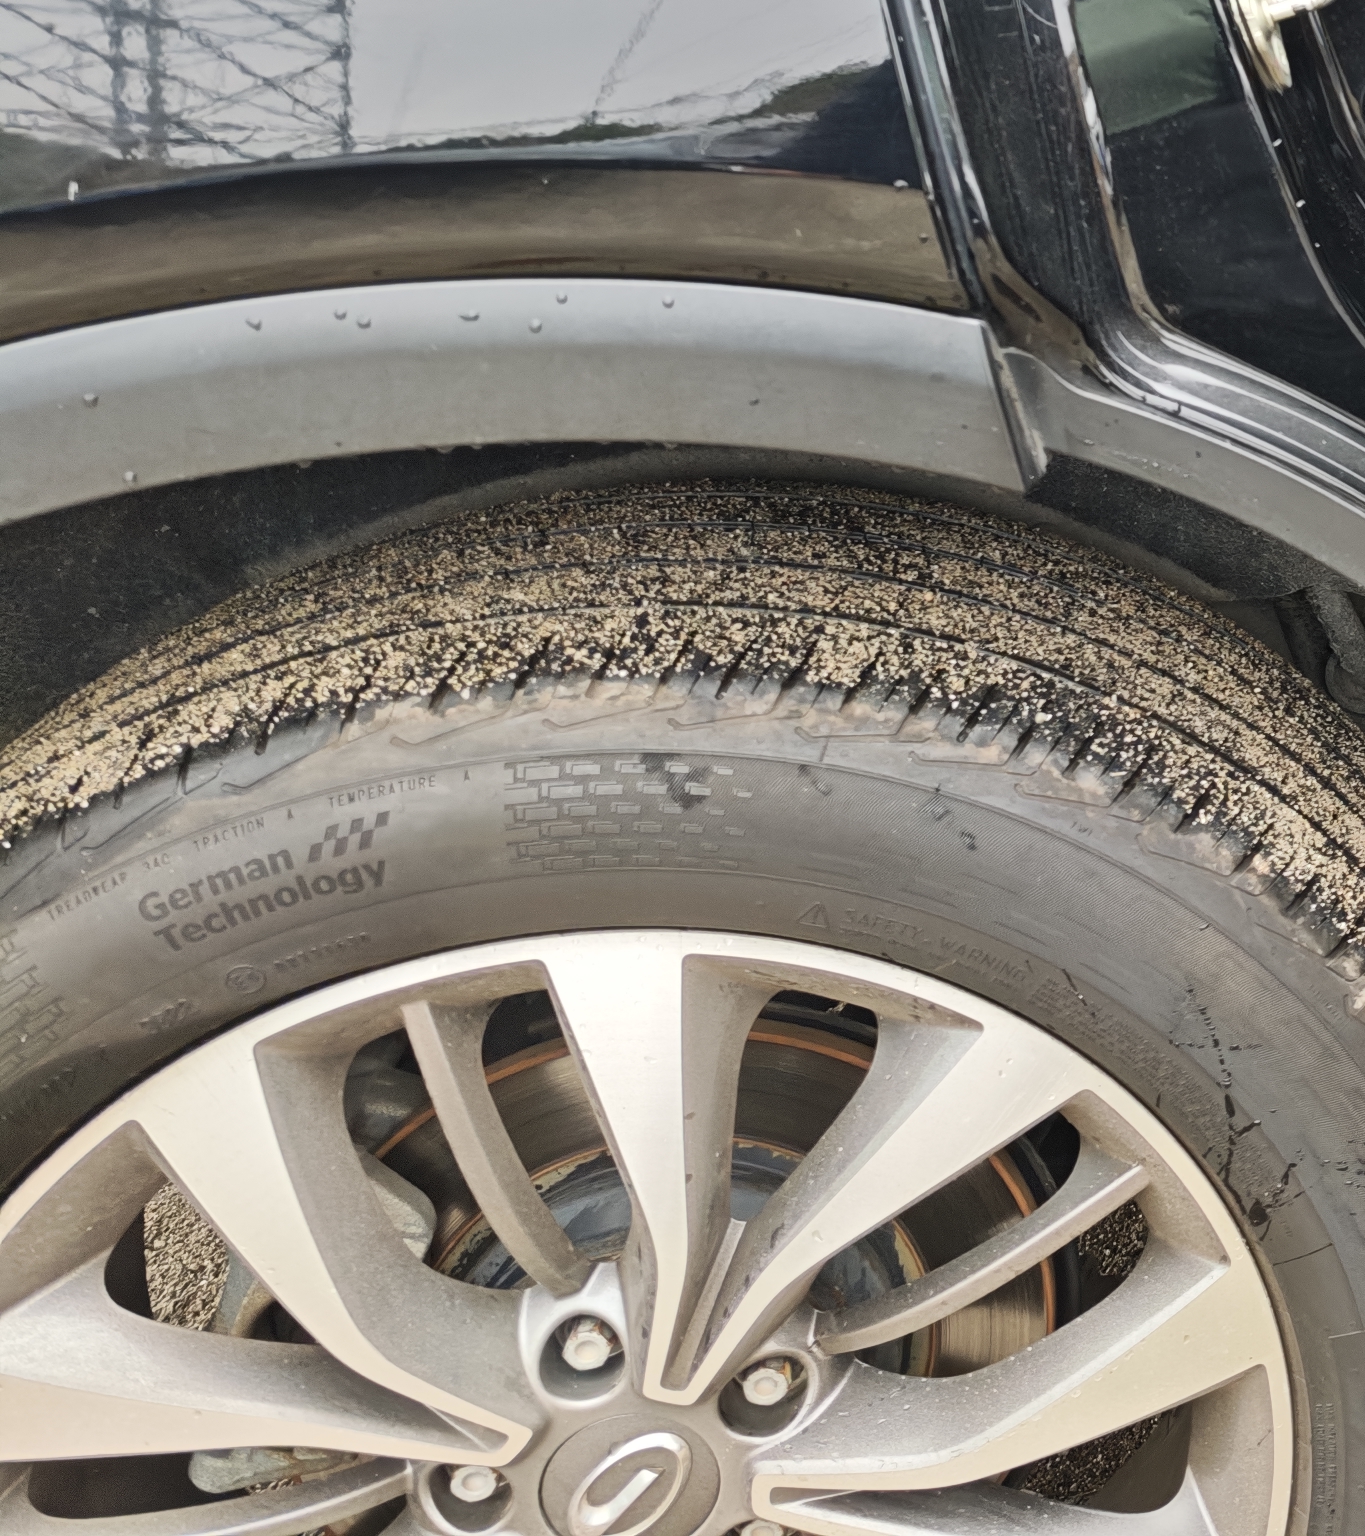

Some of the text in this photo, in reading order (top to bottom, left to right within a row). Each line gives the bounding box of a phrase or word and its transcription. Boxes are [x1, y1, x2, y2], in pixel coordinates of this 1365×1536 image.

[47, 872, 127, 921] TREADWEAR
[193, 817, 265, 852] TRACTION
[328, 775, 437, 808] TEMPERATURE
[138, 848, 294, 922] German
[153, 859, 386, 952] Technology
